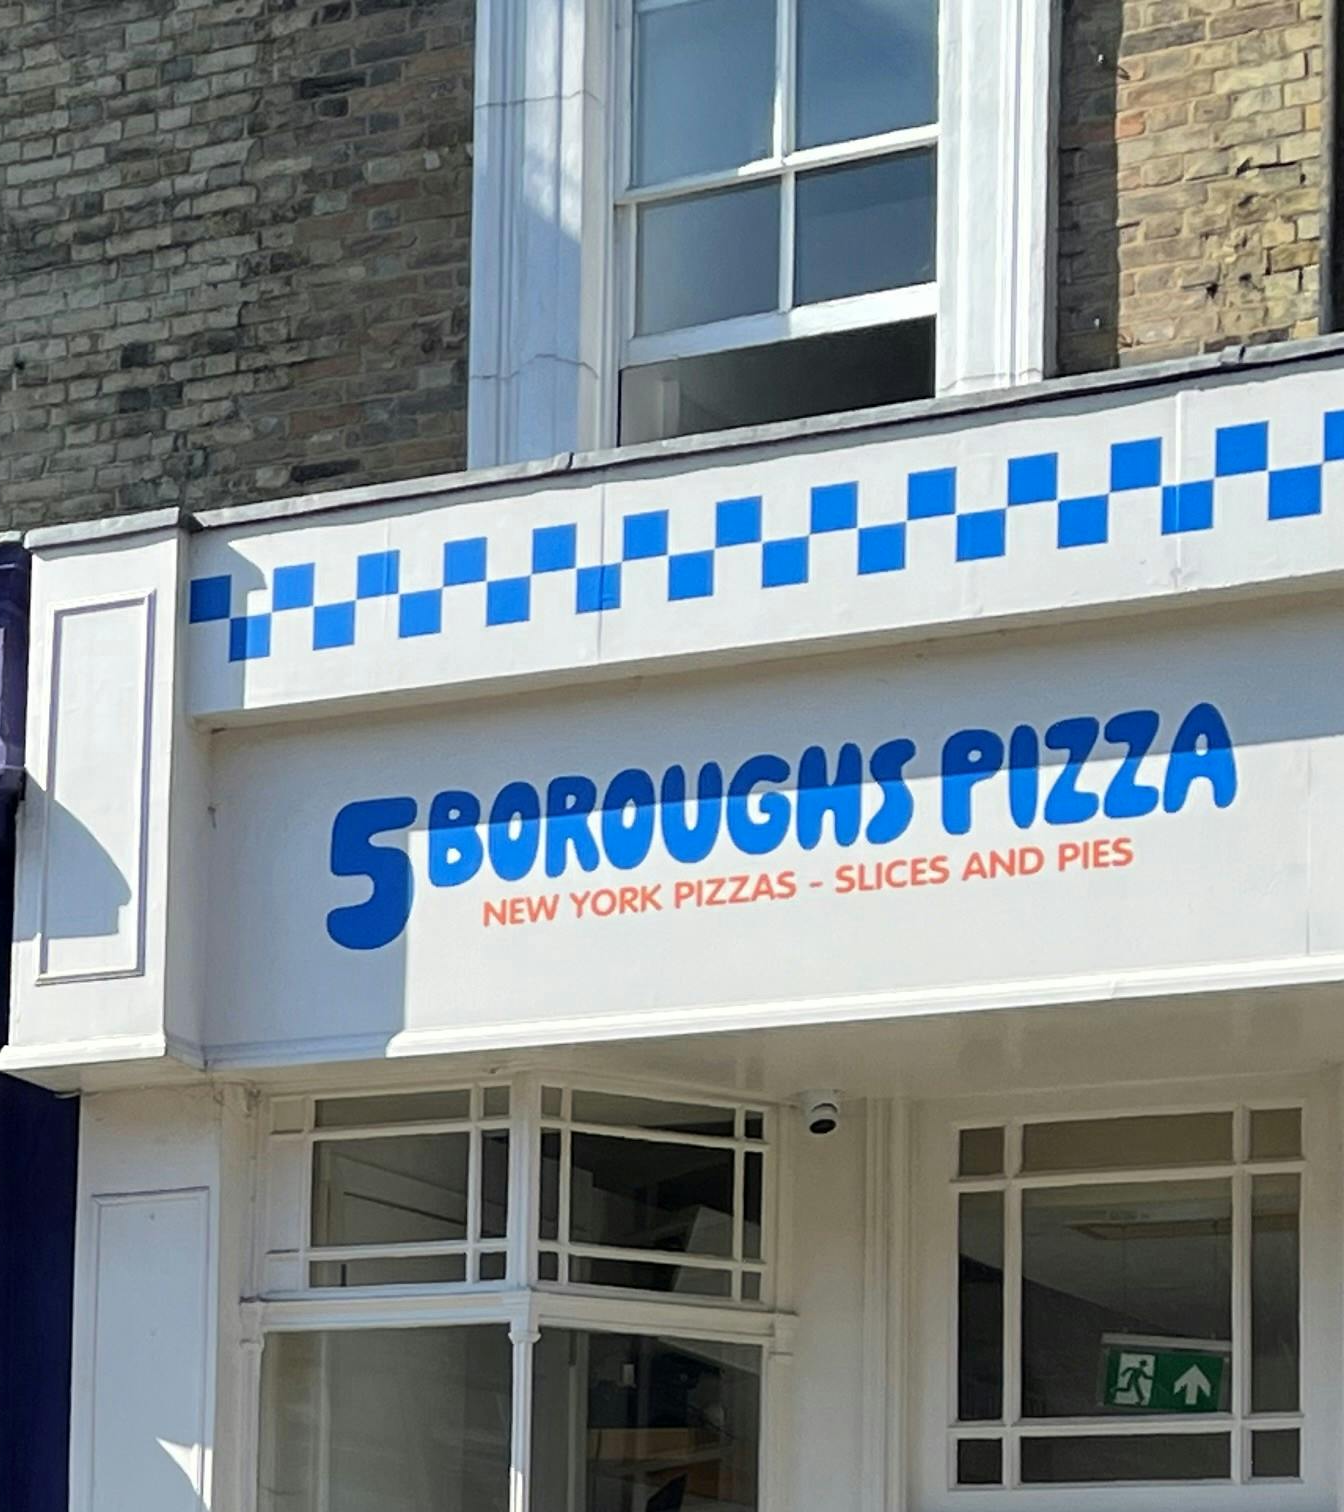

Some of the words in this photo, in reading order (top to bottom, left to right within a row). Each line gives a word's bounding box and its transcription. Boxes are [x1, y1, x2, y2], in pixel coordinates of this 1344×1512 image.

[326, 796, 417, 950] 5
[428, 739, 916, 887] BOROUGHS
[942, 702, 1238, 835] PIZZA
[483, 893, 559, 927] NEW
[569, 884, 662, 919] YORK
[674, 870, 796, 909] PIZZAS
[835, 855, 950, 894] SLICES
[962, 846, 1045, 881] AND
[1057, 837, 1134, 871] PIES
